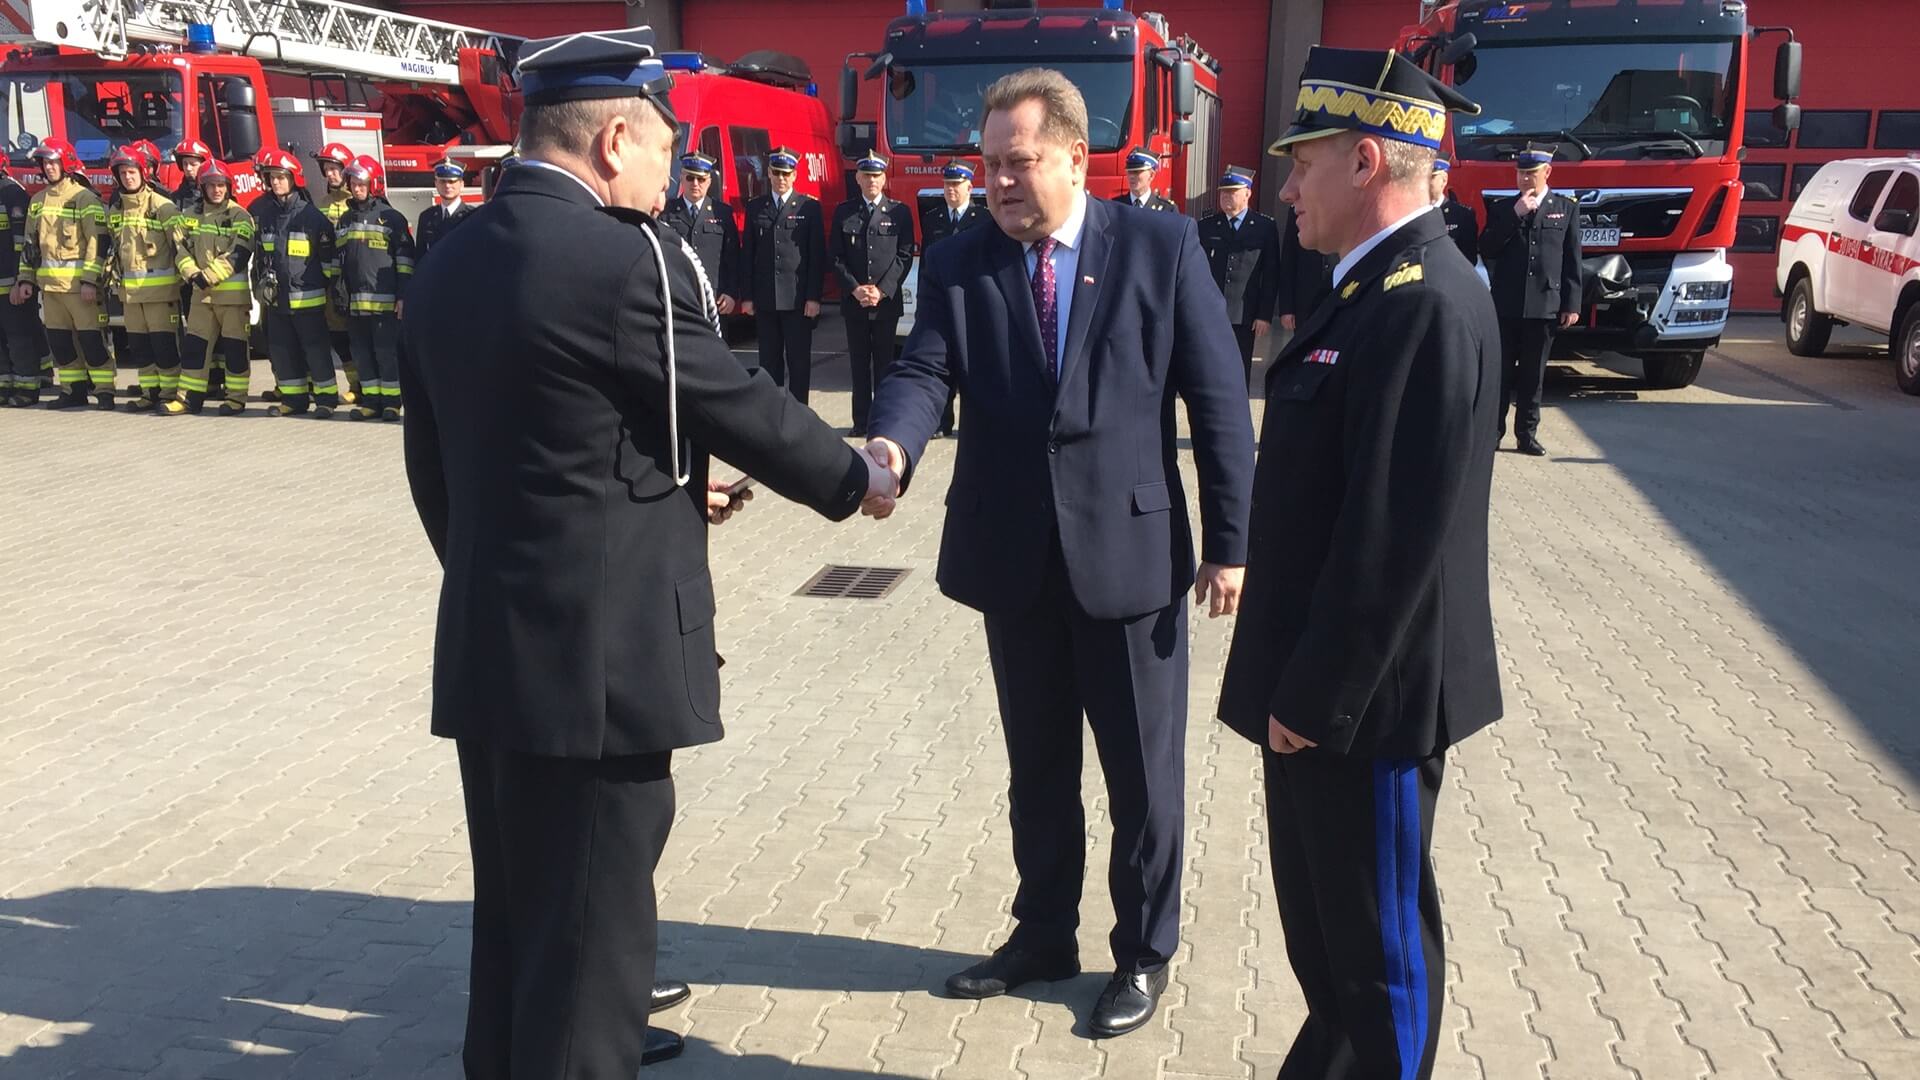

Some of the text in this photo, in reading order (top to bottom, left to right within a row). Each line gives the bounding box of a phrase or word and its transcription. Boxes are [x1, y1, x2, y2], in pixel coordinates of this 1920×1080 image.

[400, 61, 434, 75] MAGIRUS
[904, 166, 941, 174] STOLARCZ
[1580, 214, 1618, 226] AN
